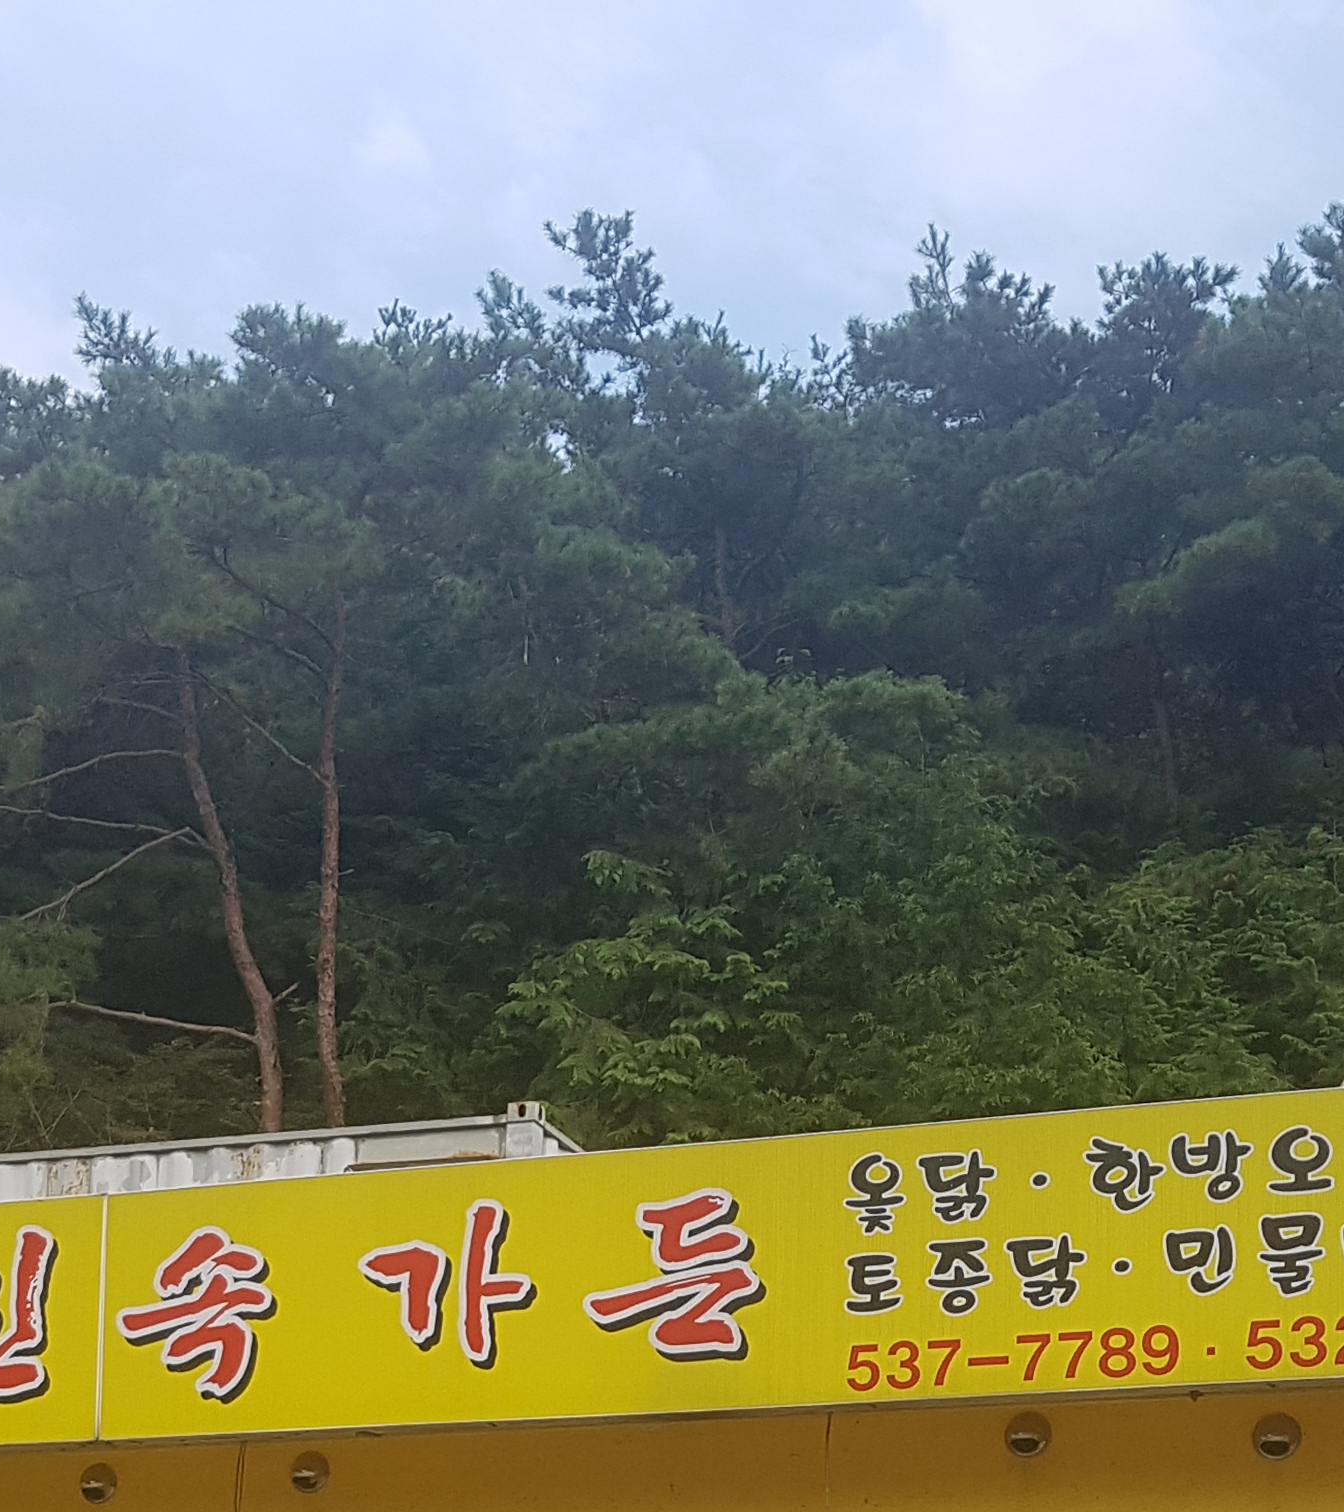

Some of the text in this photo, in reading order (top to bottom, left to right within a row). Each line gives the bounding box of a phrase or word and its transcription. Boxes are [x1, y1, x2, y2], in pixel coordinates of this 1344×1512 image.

[843, 1149, 997, 1235] 옻닭
[844, 1232, 1087, 1317] 토종닭
[846, 1323, 1180, 1392] 537-7789
